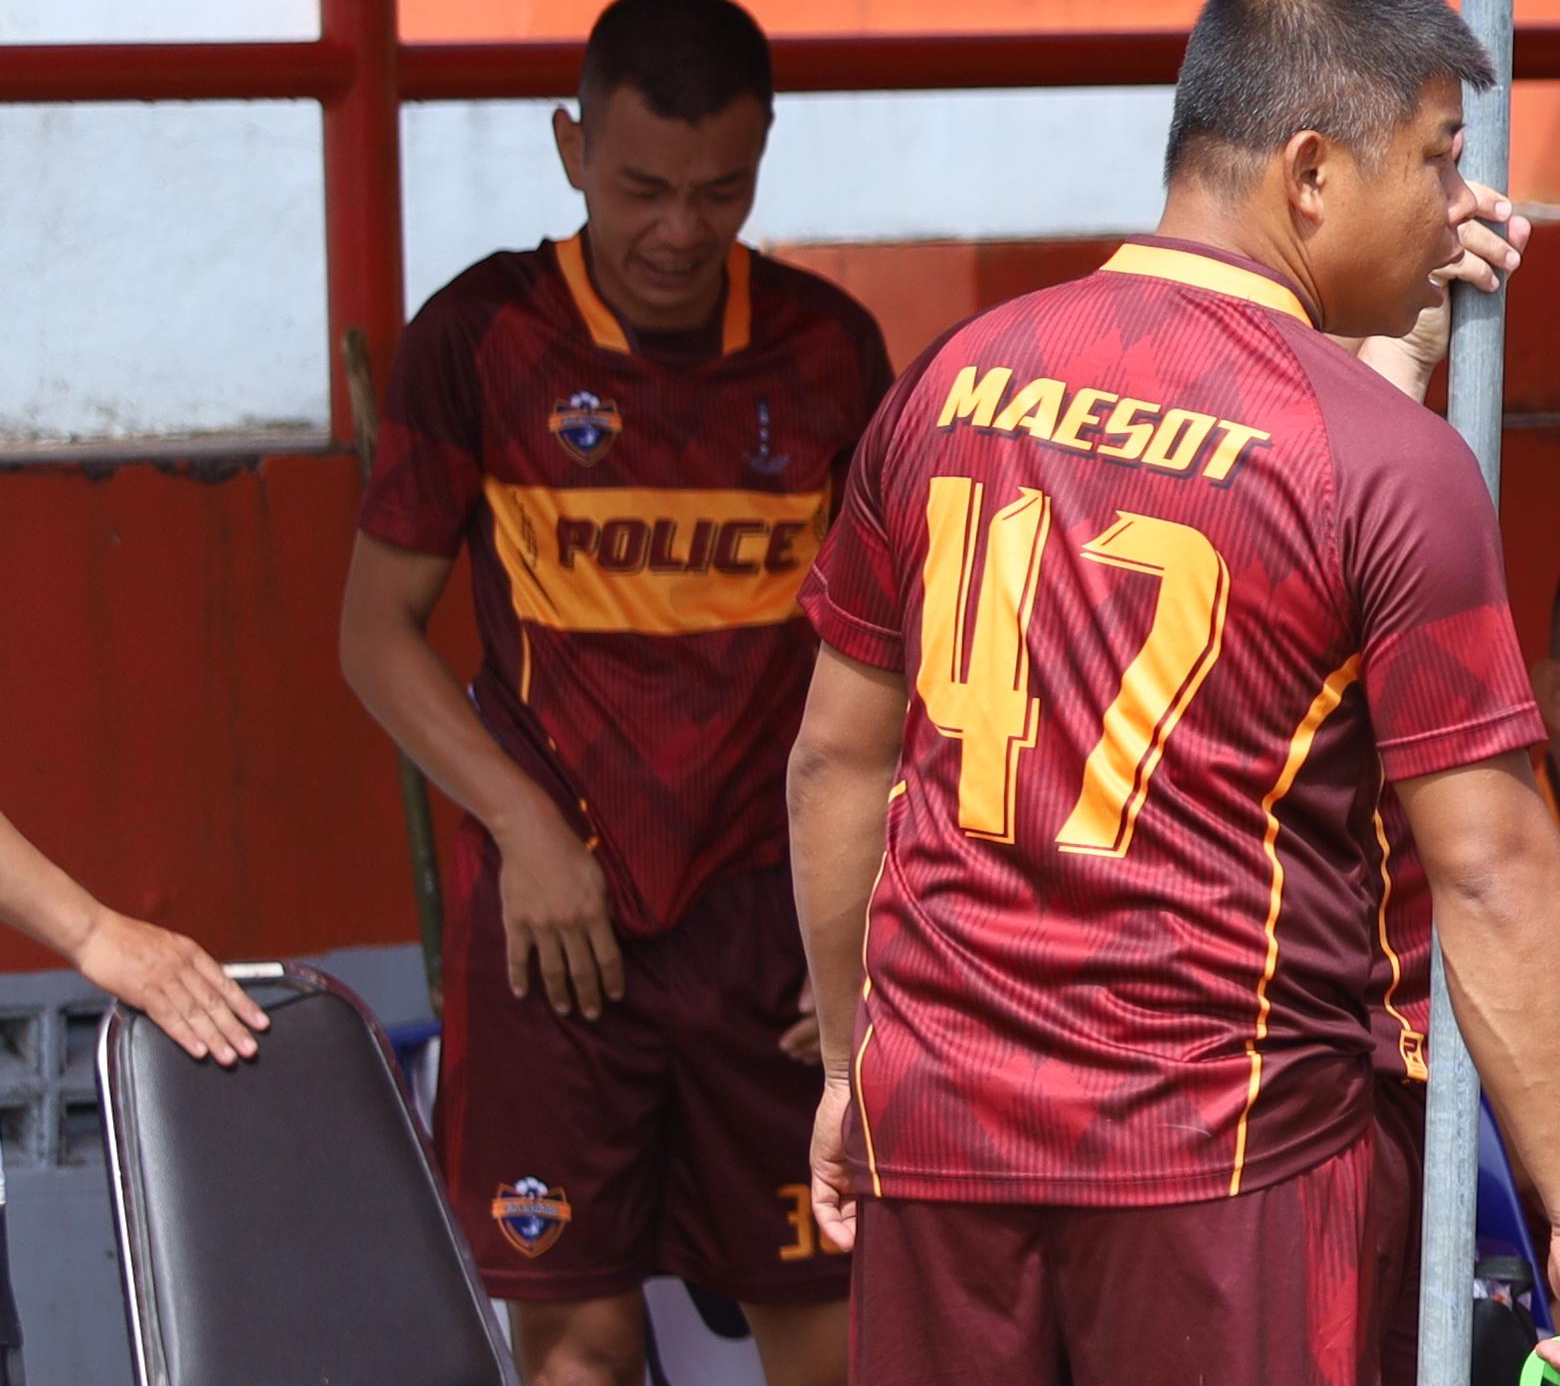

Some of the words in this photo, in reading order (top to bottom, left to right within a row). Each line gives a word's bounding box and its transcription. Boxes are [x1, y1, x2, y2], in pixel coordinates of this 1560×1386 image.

[936, 365, 1271, 489] MAESOT
[557, 516, 807, 576] POLICE
[917, 475, 1232, 859] 47
